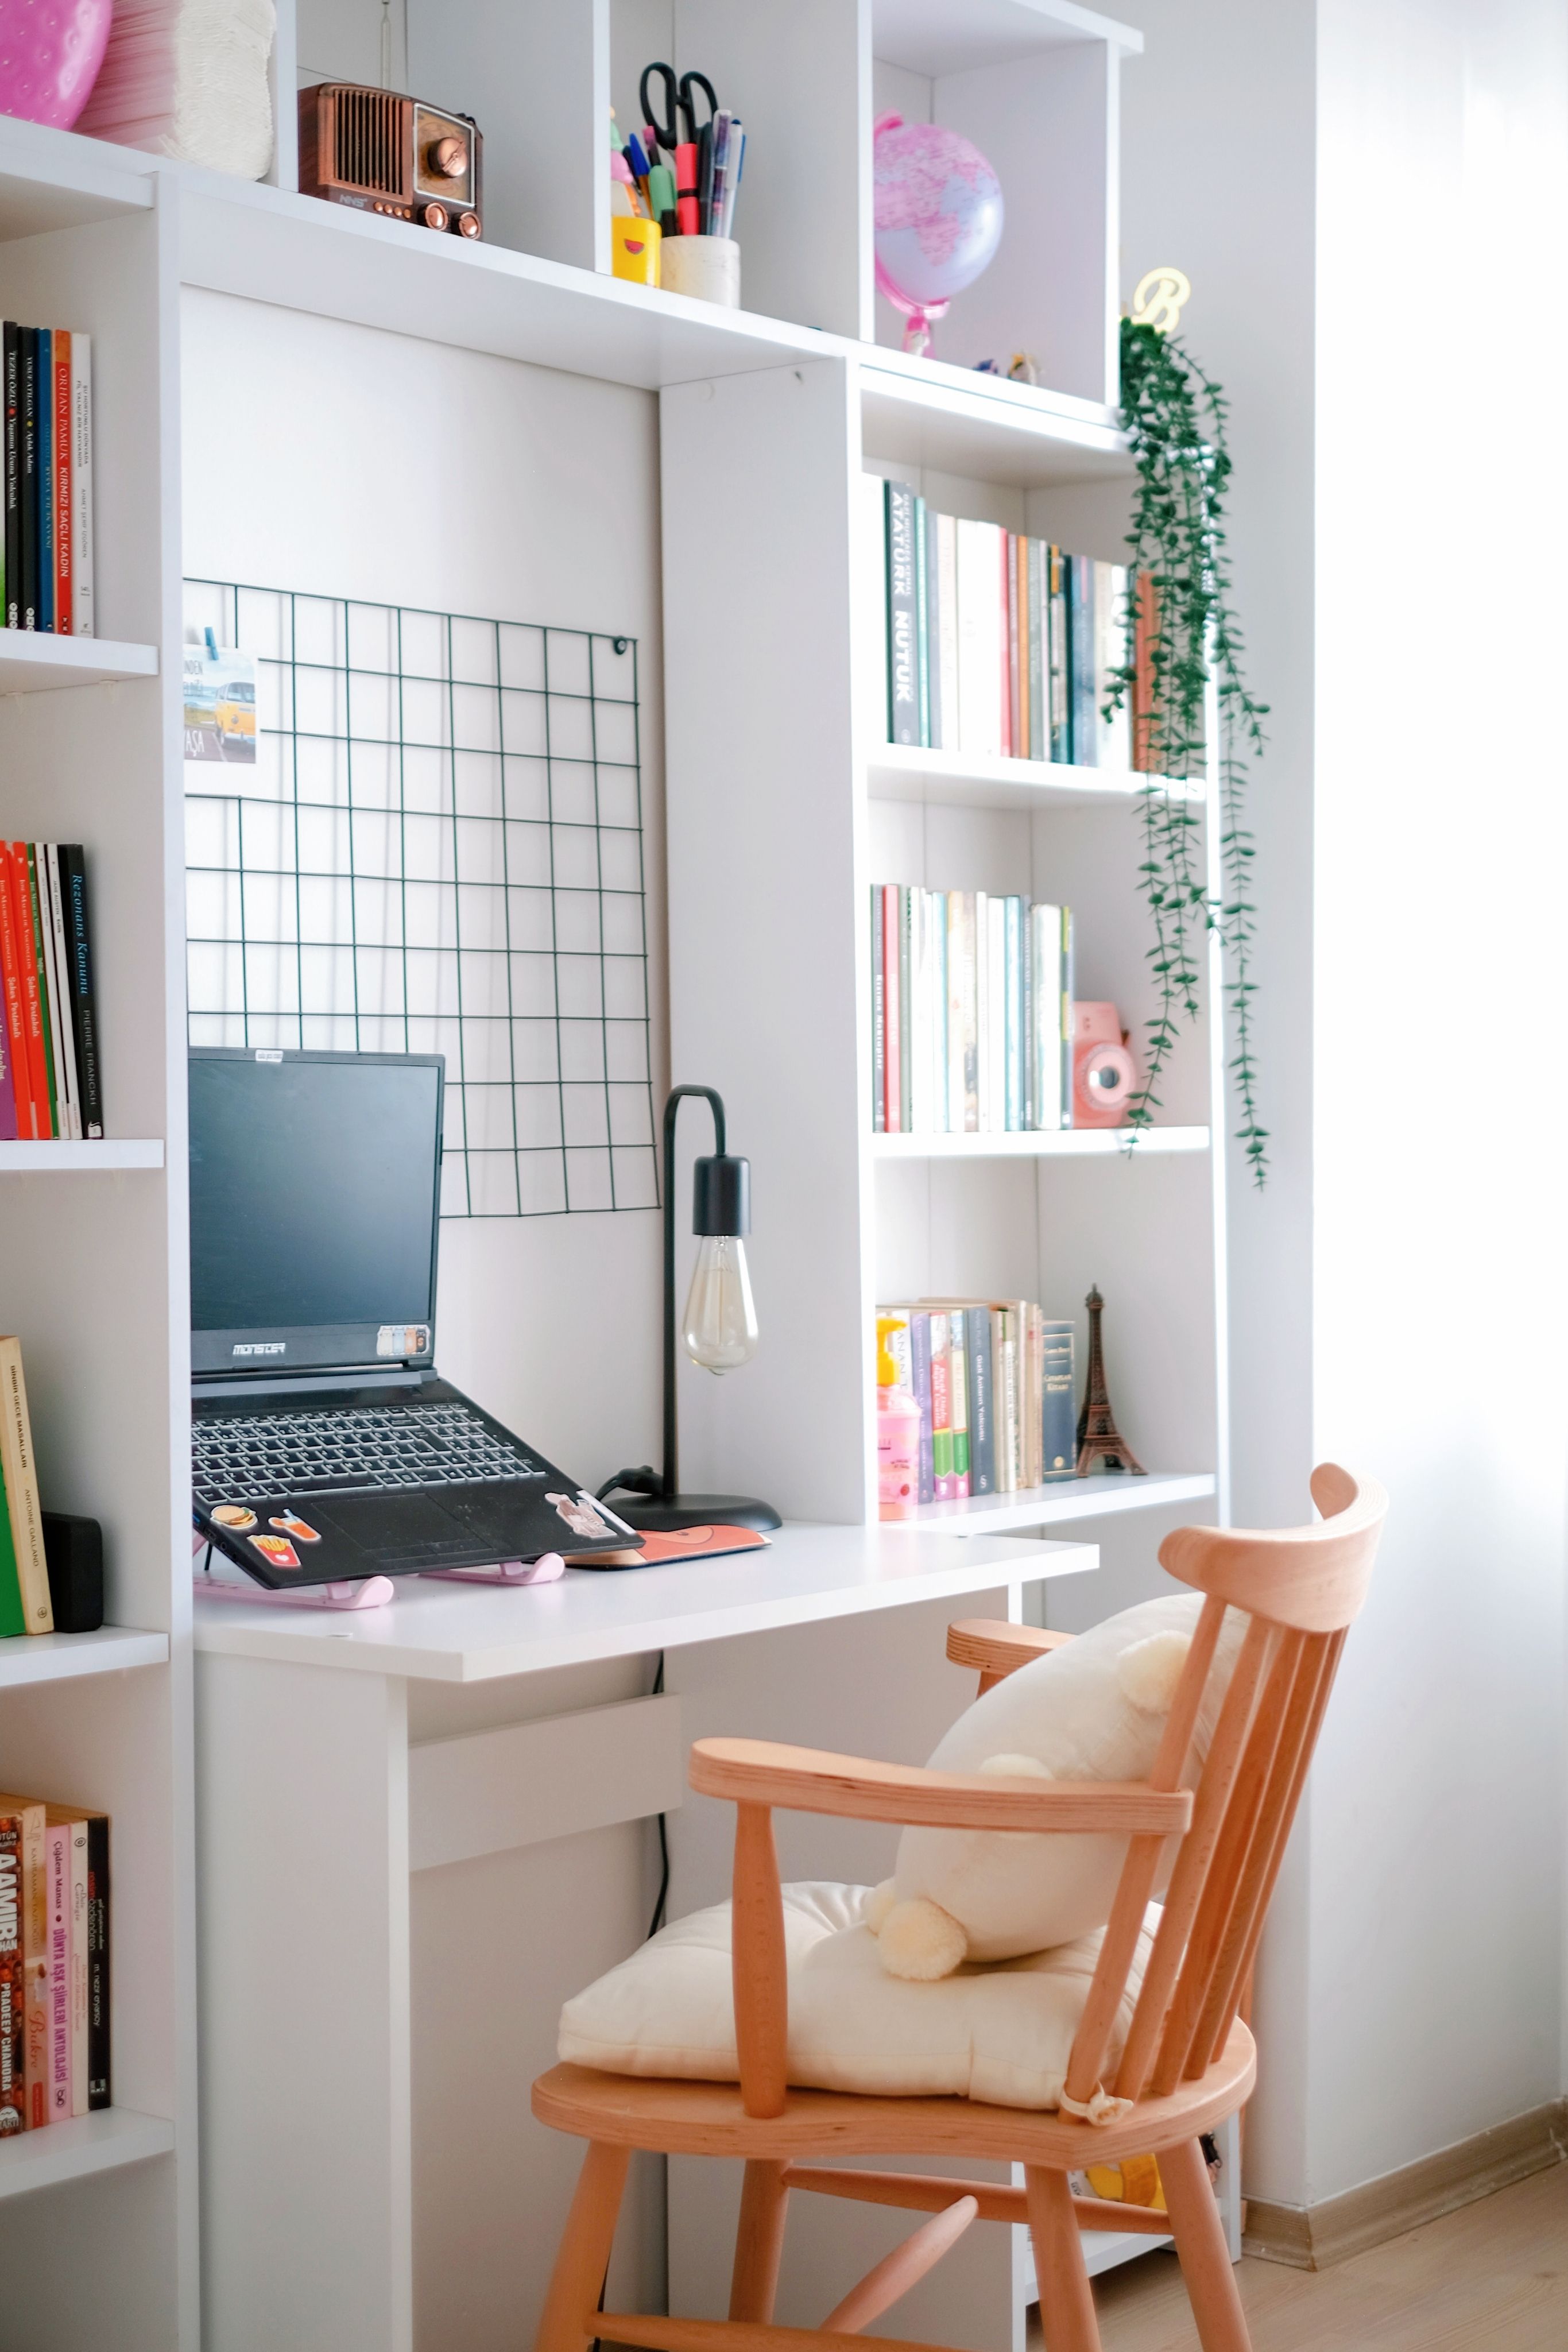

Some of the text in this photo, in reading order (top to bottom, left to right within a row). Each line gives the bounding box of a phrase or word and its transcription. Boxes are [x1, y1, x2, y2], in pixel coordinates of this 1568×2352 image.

[9, 351, 17, 380] TEZER
[59, 368, 69, 460] ORHAN PAMUK
[59, 467, 69, 577] KIRMIZI SAÇLI KADIN
[895, 610, 910, 702] NUTUK
[184, 729, 205, 757] AŞA
[72, 875, 88, 995] Rezonans Kanunu
[83, 1010, 97, 1105] PIERRE FRANCKH
[233, 1342, 286, 1355] MONSTER
[10, 1365, 28, 1468] BİNBİR GECE MASALLARI
[25, 1488, 40, 1566] ANTOINE GALLAND
[53, 1841, 64, 1909] Çiğdem Manas
[50, 1963, 66, 1983] AŞK
[53, 1928, 68, 1960] DÜNYA
[1, 1982, 12, 2092] PRADEEP CHANDRA
[29, 2010, 47, 2068] Bukre
[54, 2028, 68, 2083] ANTOLOJİSİ
